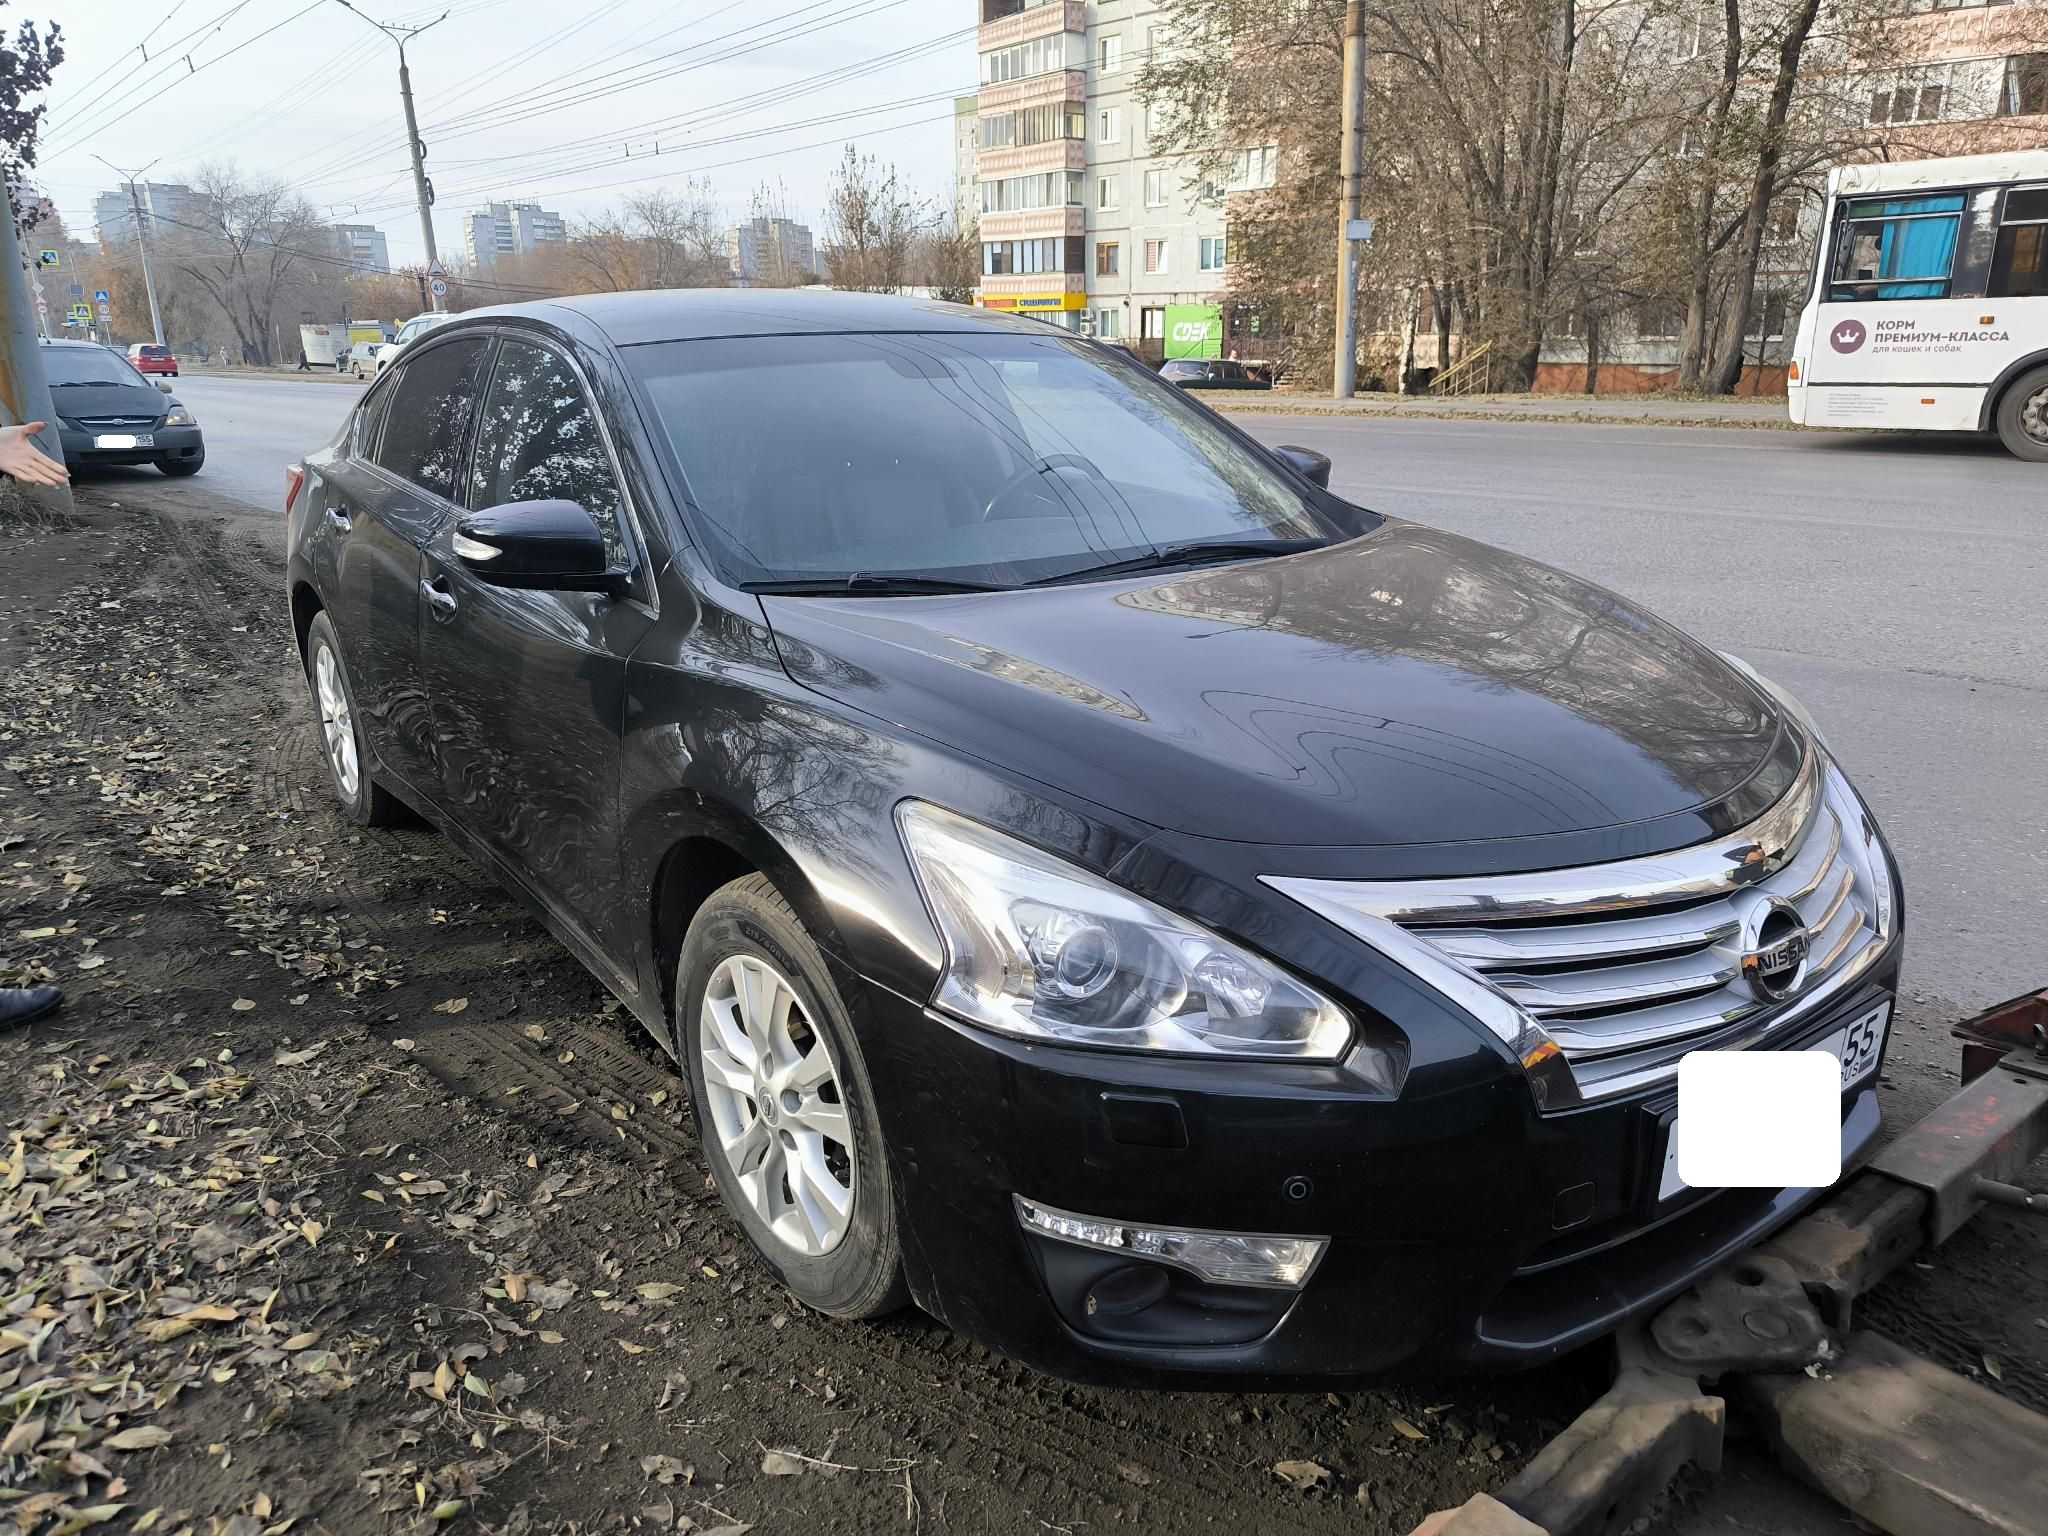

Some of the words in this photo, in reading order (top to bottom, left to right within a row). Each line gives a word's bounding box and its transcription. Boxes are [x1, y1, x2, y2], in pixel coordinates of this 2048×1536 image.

[433, 283, 445, 292] 40
[1876, 320, 1916, 331] КОРМ
[1874, 331, 2010, 343] ПРЕМИУМ-КЛАССА
[1872, 345, 1890, 353] для
[1892, 345, 1922, 353] кошек
[1933, 344, 1962, 353] собак
[1758, 935, 1811, 972] NISSAN
[1844, 1012, 1879, 1067] 55
